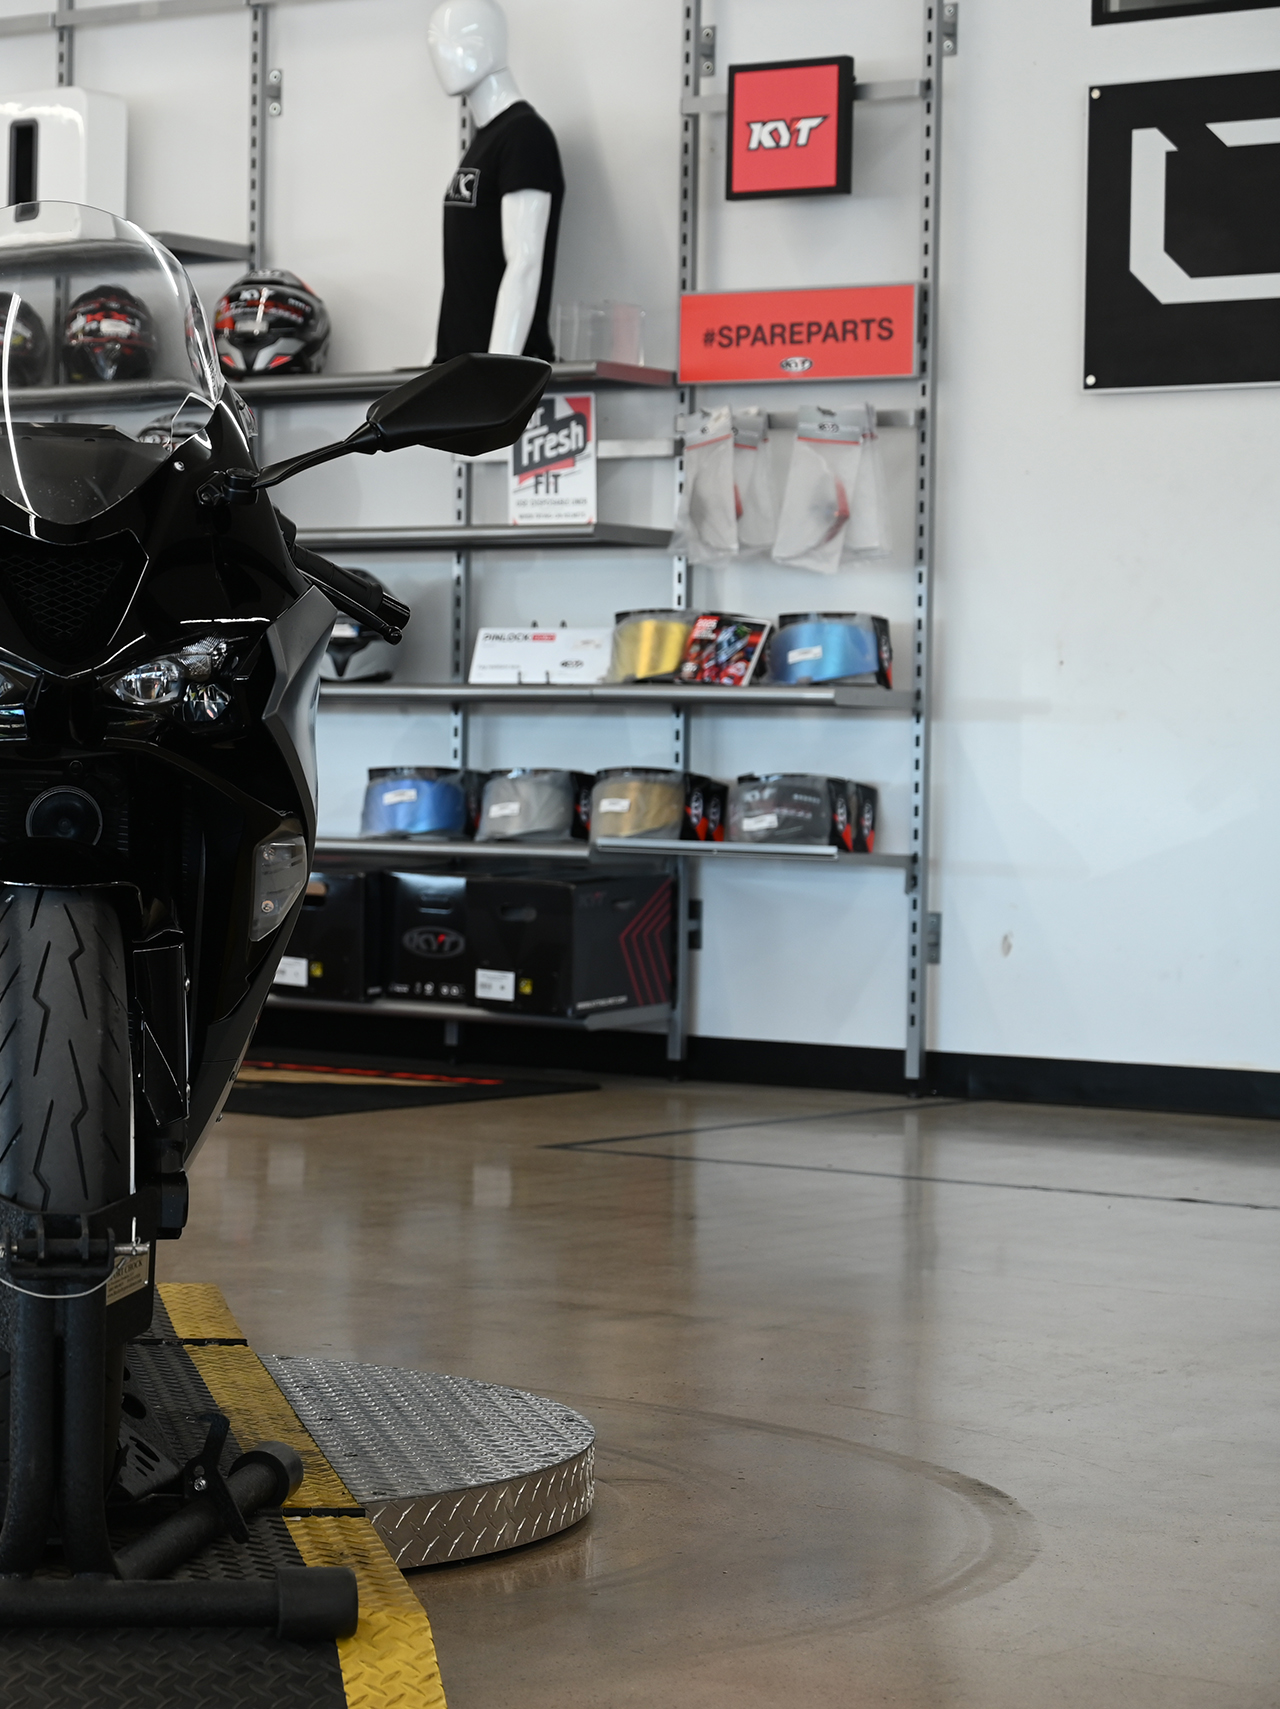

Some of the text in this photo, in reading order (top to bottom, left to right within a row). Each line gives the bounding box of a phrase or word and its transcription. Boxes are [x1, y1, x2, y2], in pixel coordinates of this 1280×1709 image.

[746, 115, 829, 150] KYT
[703, 317, 894, 348] #SPAREPARTS
[521, 420, 585, 466] Fresh
[534, 471, 561, 494] FIT
